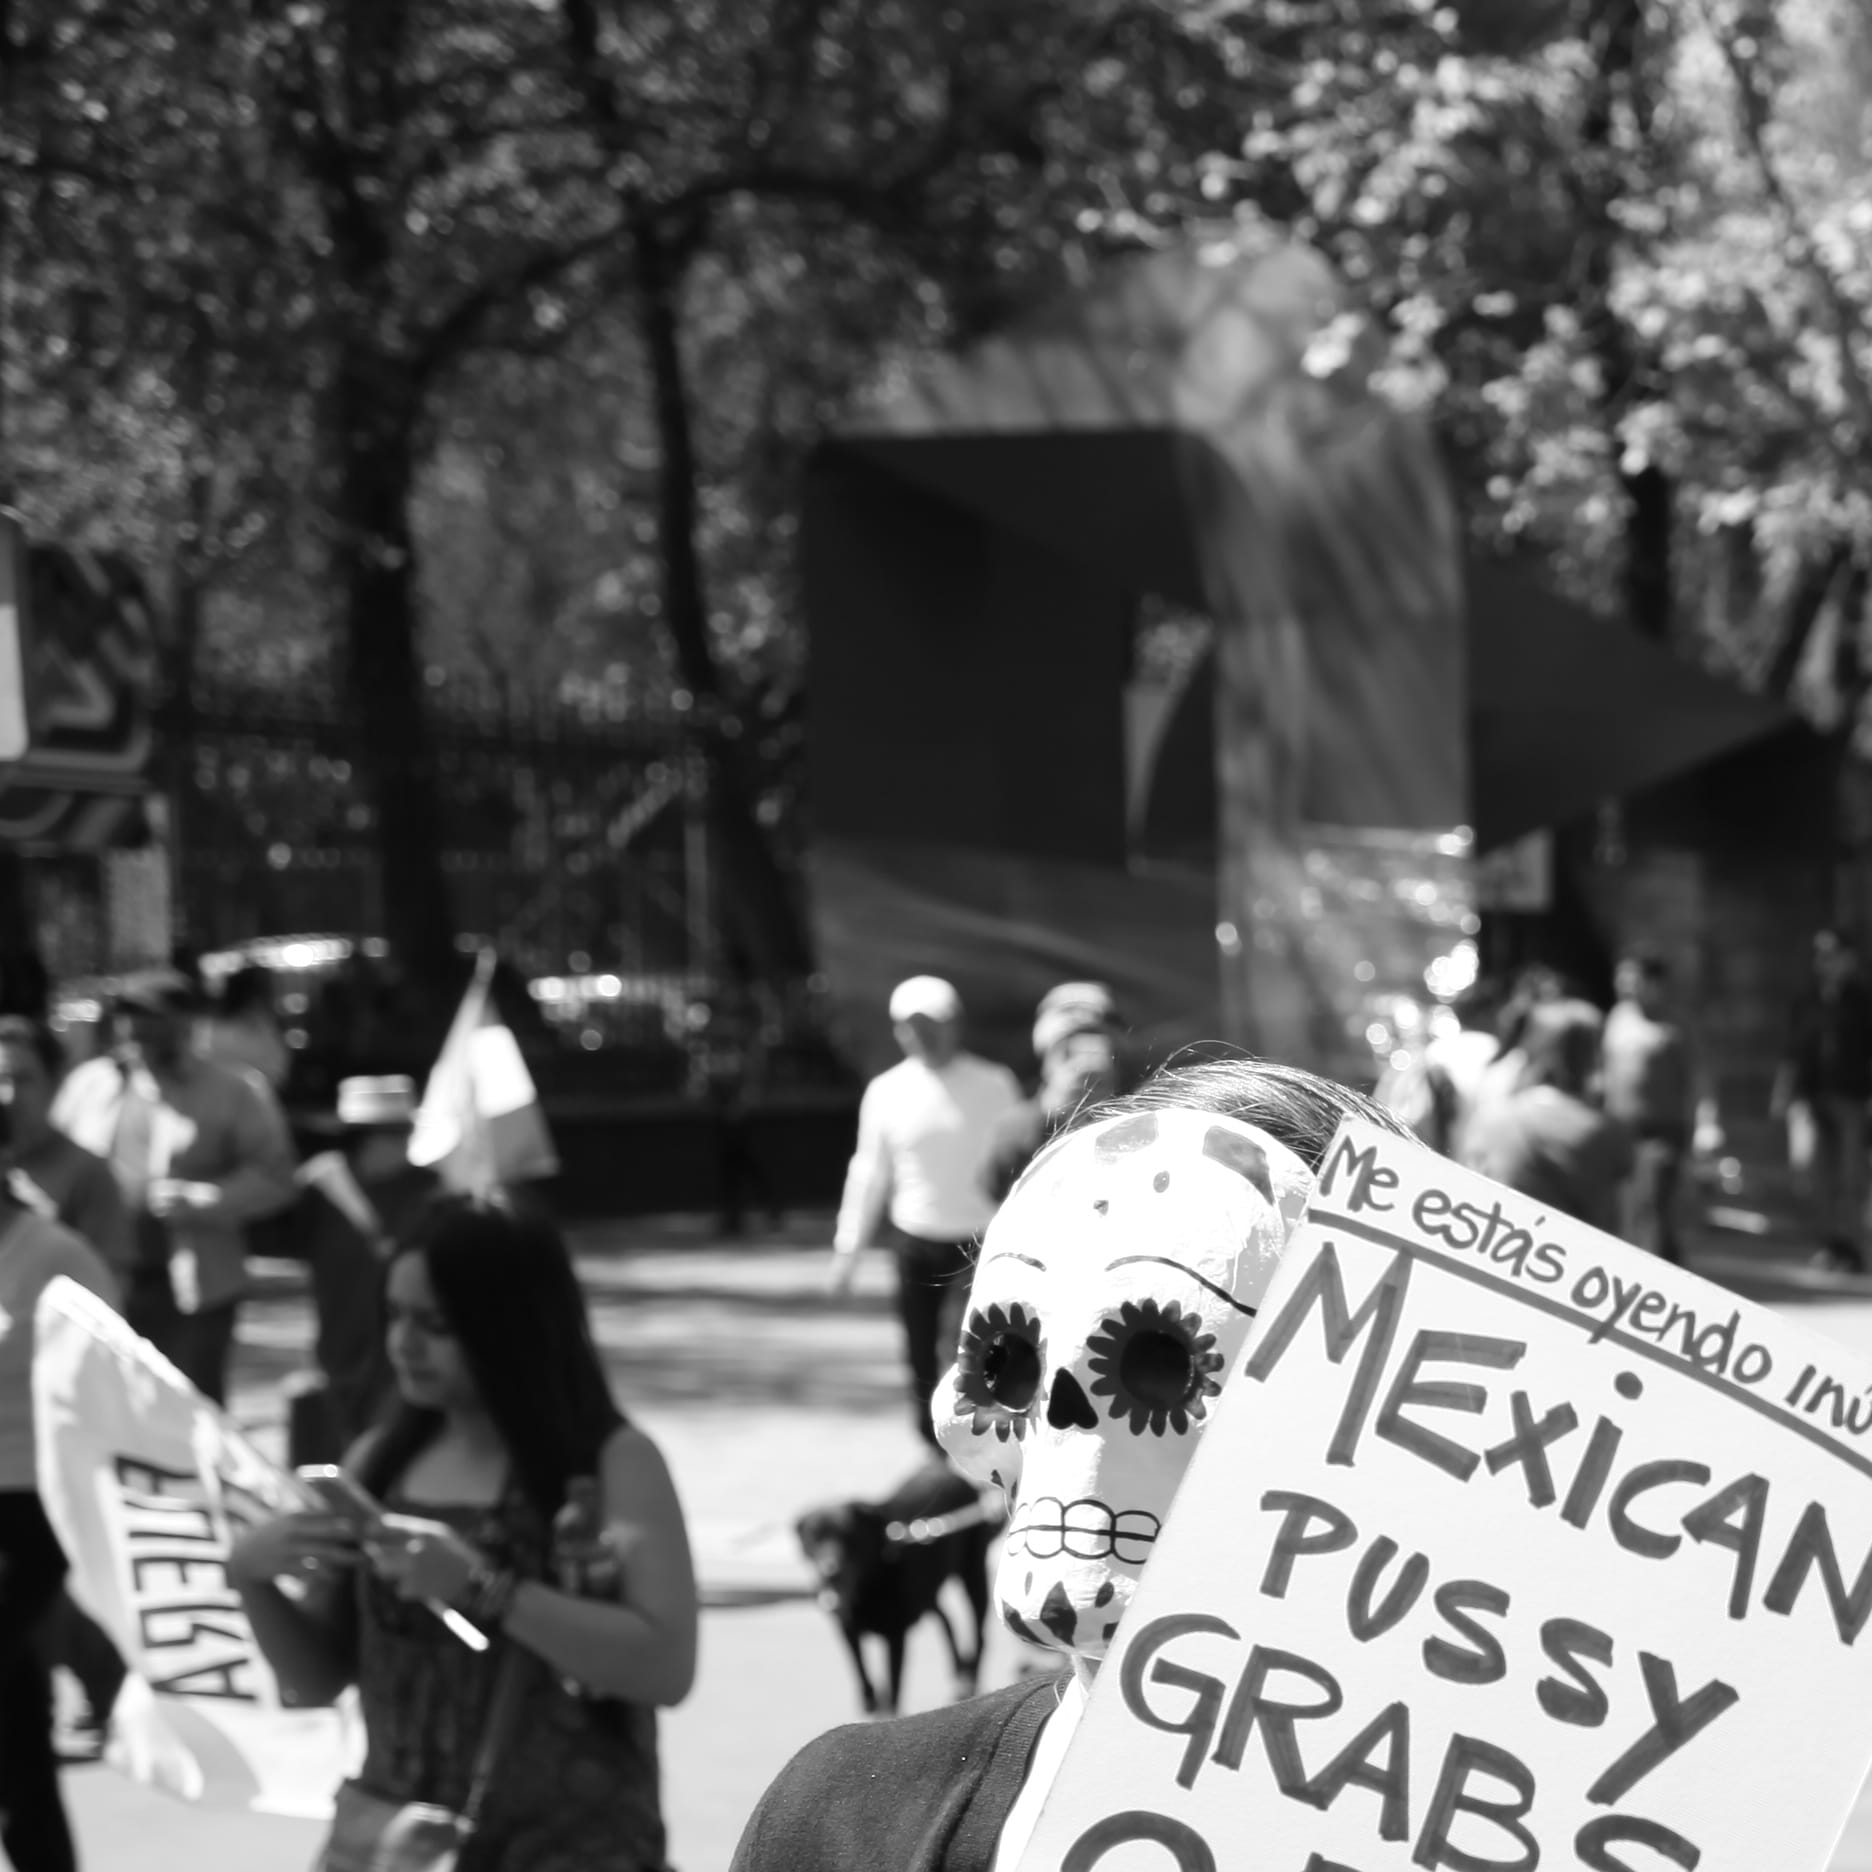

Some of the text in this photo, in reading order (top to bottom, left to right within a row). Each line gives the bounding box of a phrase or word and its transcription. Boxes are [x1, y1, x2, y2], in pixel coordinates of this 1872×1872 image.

[1318, 1136, 1399, 1212] Me
[1412, 1187, 1568, 1285] estás
[1569, 1262, 1773, 1386] oyendo
[1260, 1489, 1740, 1805] PUSSY
